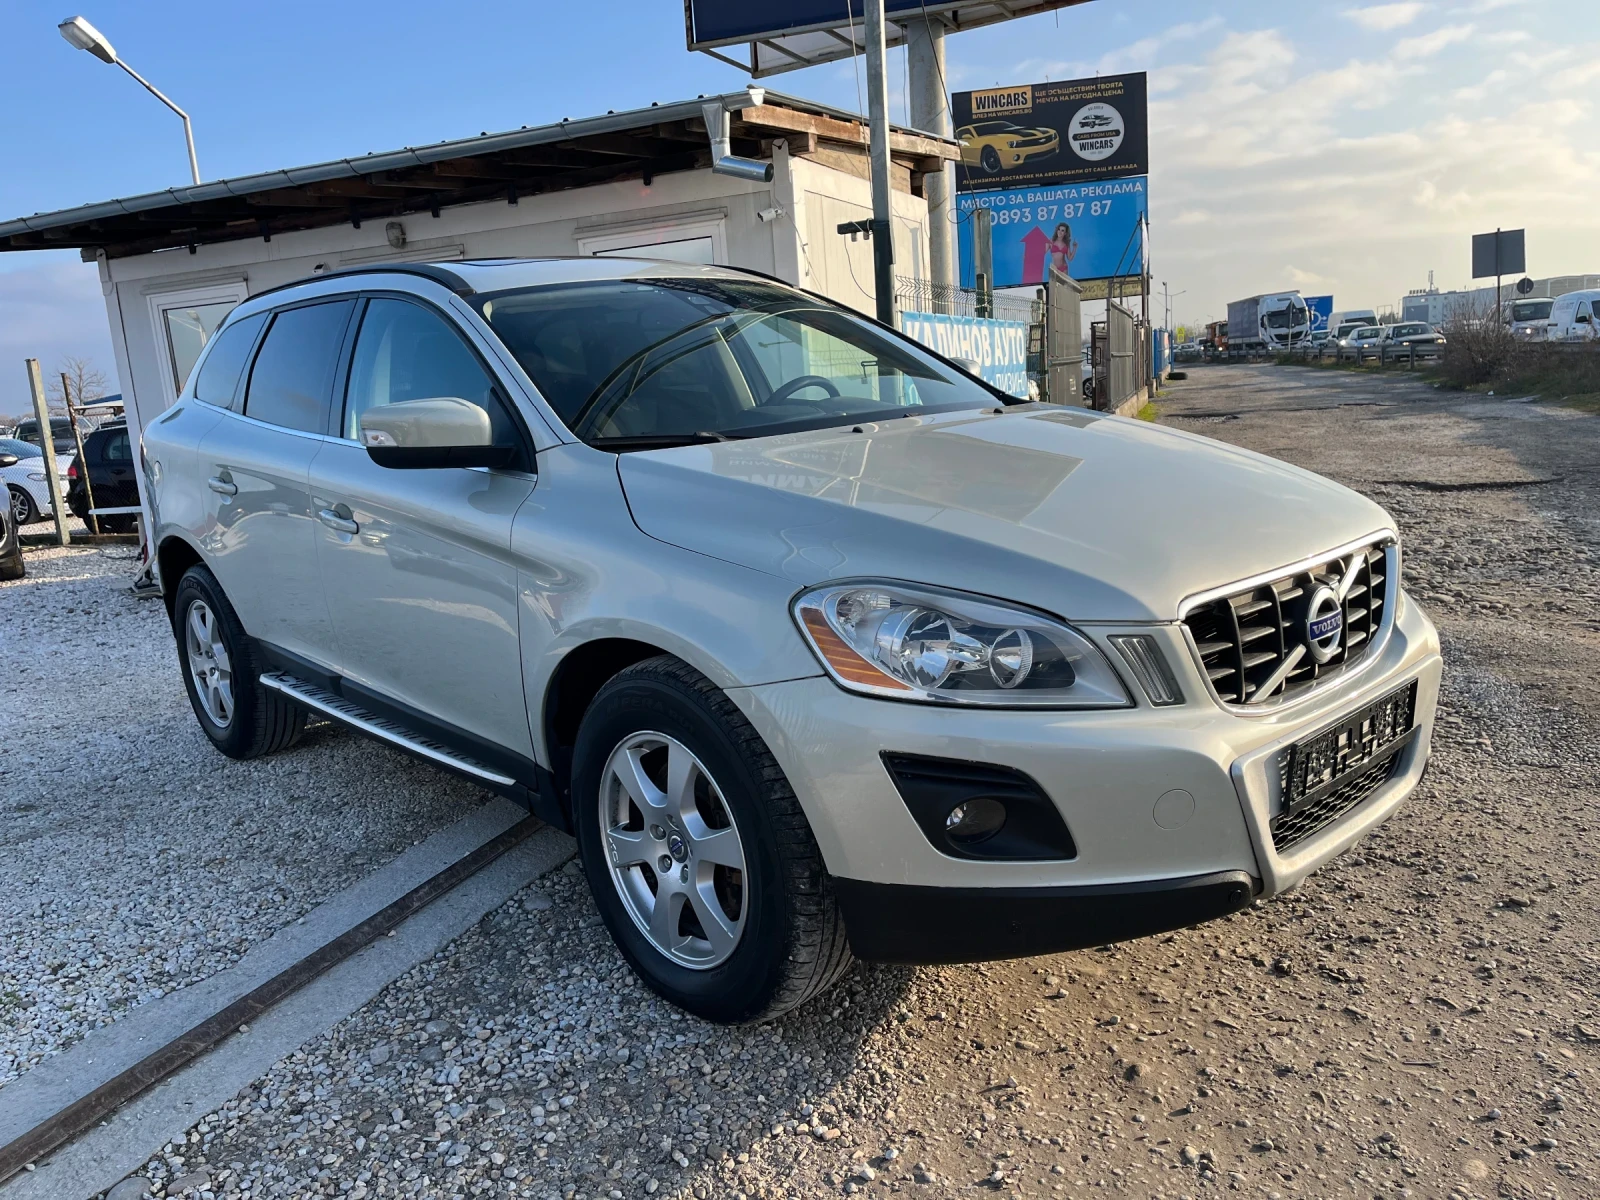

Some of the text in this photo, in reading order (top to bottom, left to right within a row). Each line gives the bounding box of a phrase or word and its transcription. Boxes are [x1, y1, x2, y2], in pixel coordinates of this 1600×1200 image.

[1036, 96, 1059, 104] МЕЧТА
[1070, 91, 1102, 100] ИЗГОДНА
[1102, 88, 1124, 97] ЦЕНА!
[1048, 84, 1096, 95] ОСЪЩЕСТВИМ
[1097, 81, 1123, 90] ТВОЯТА
[975, 91, 1028, 110] WINCARS
[997, 108, 1032, 117] WINCARS.BG
[1079, 139, 1114, 151] WINCARS
[1001, 173, 1034, 182] ДОСТАВЧИК
[1044, 169, 1083, 177] АВТОМОБИЛИ
[961, 182, 1143, 209] МЯСТО ЗА ВАШАТА РЕКЛАМА
[990, 200, 1112, 226] 0893 87 87 87
[994, 327, 1024, 366] АУТО
[1312, 615, 1342, 635] VOLVO
